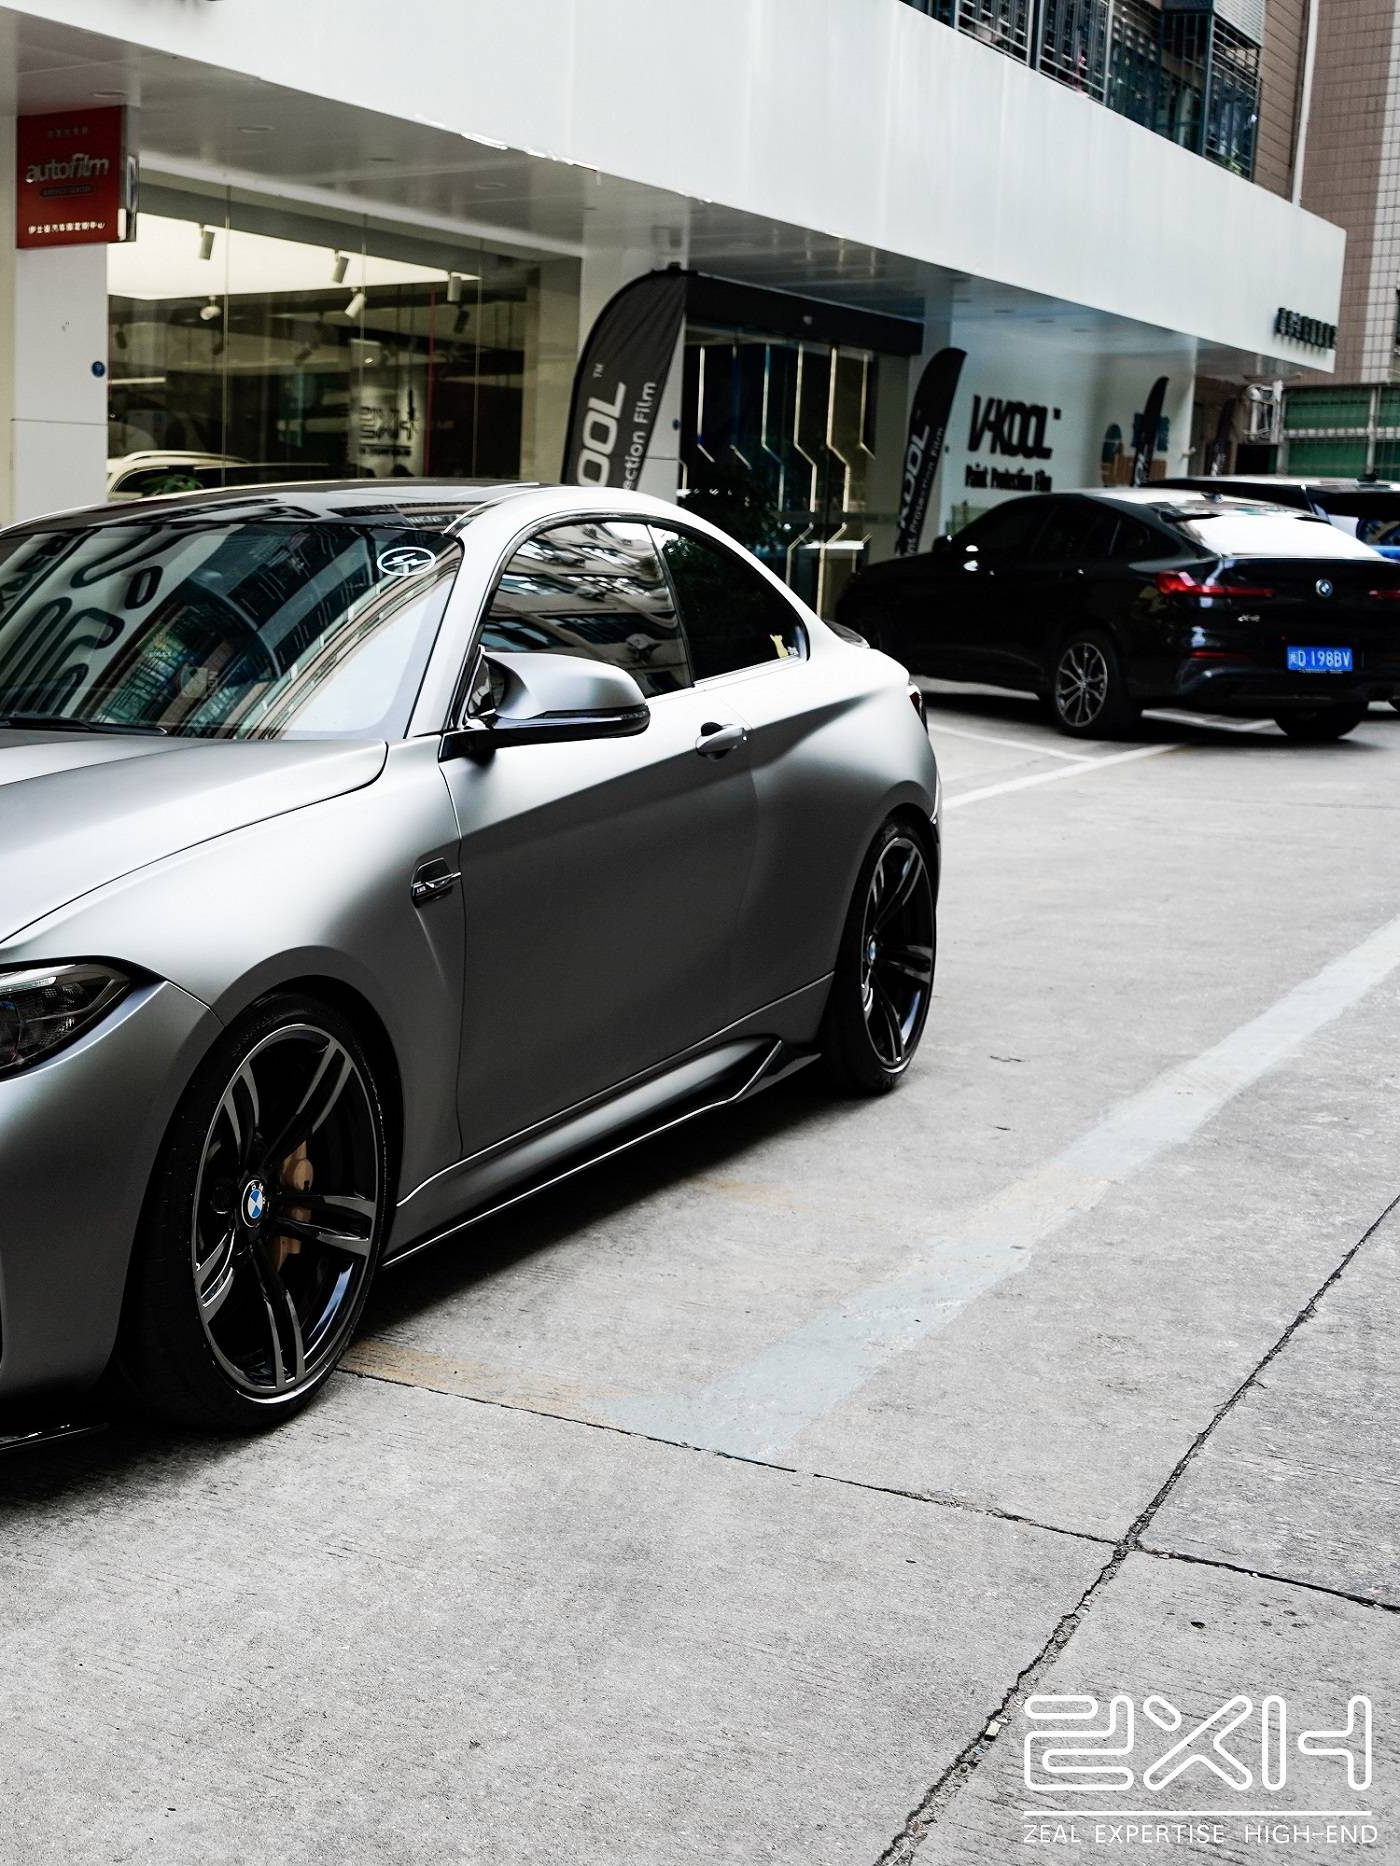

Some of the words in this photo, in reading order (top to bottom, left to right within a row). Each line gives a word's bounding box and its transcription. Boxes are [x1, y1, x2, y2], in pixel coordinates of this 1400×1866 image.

[25, 153, 109, 183] autofilm
[633, 382, 657, 424] Film
[576, 381, 627, 487] OOL
[622, 431, 647, 490] ection
